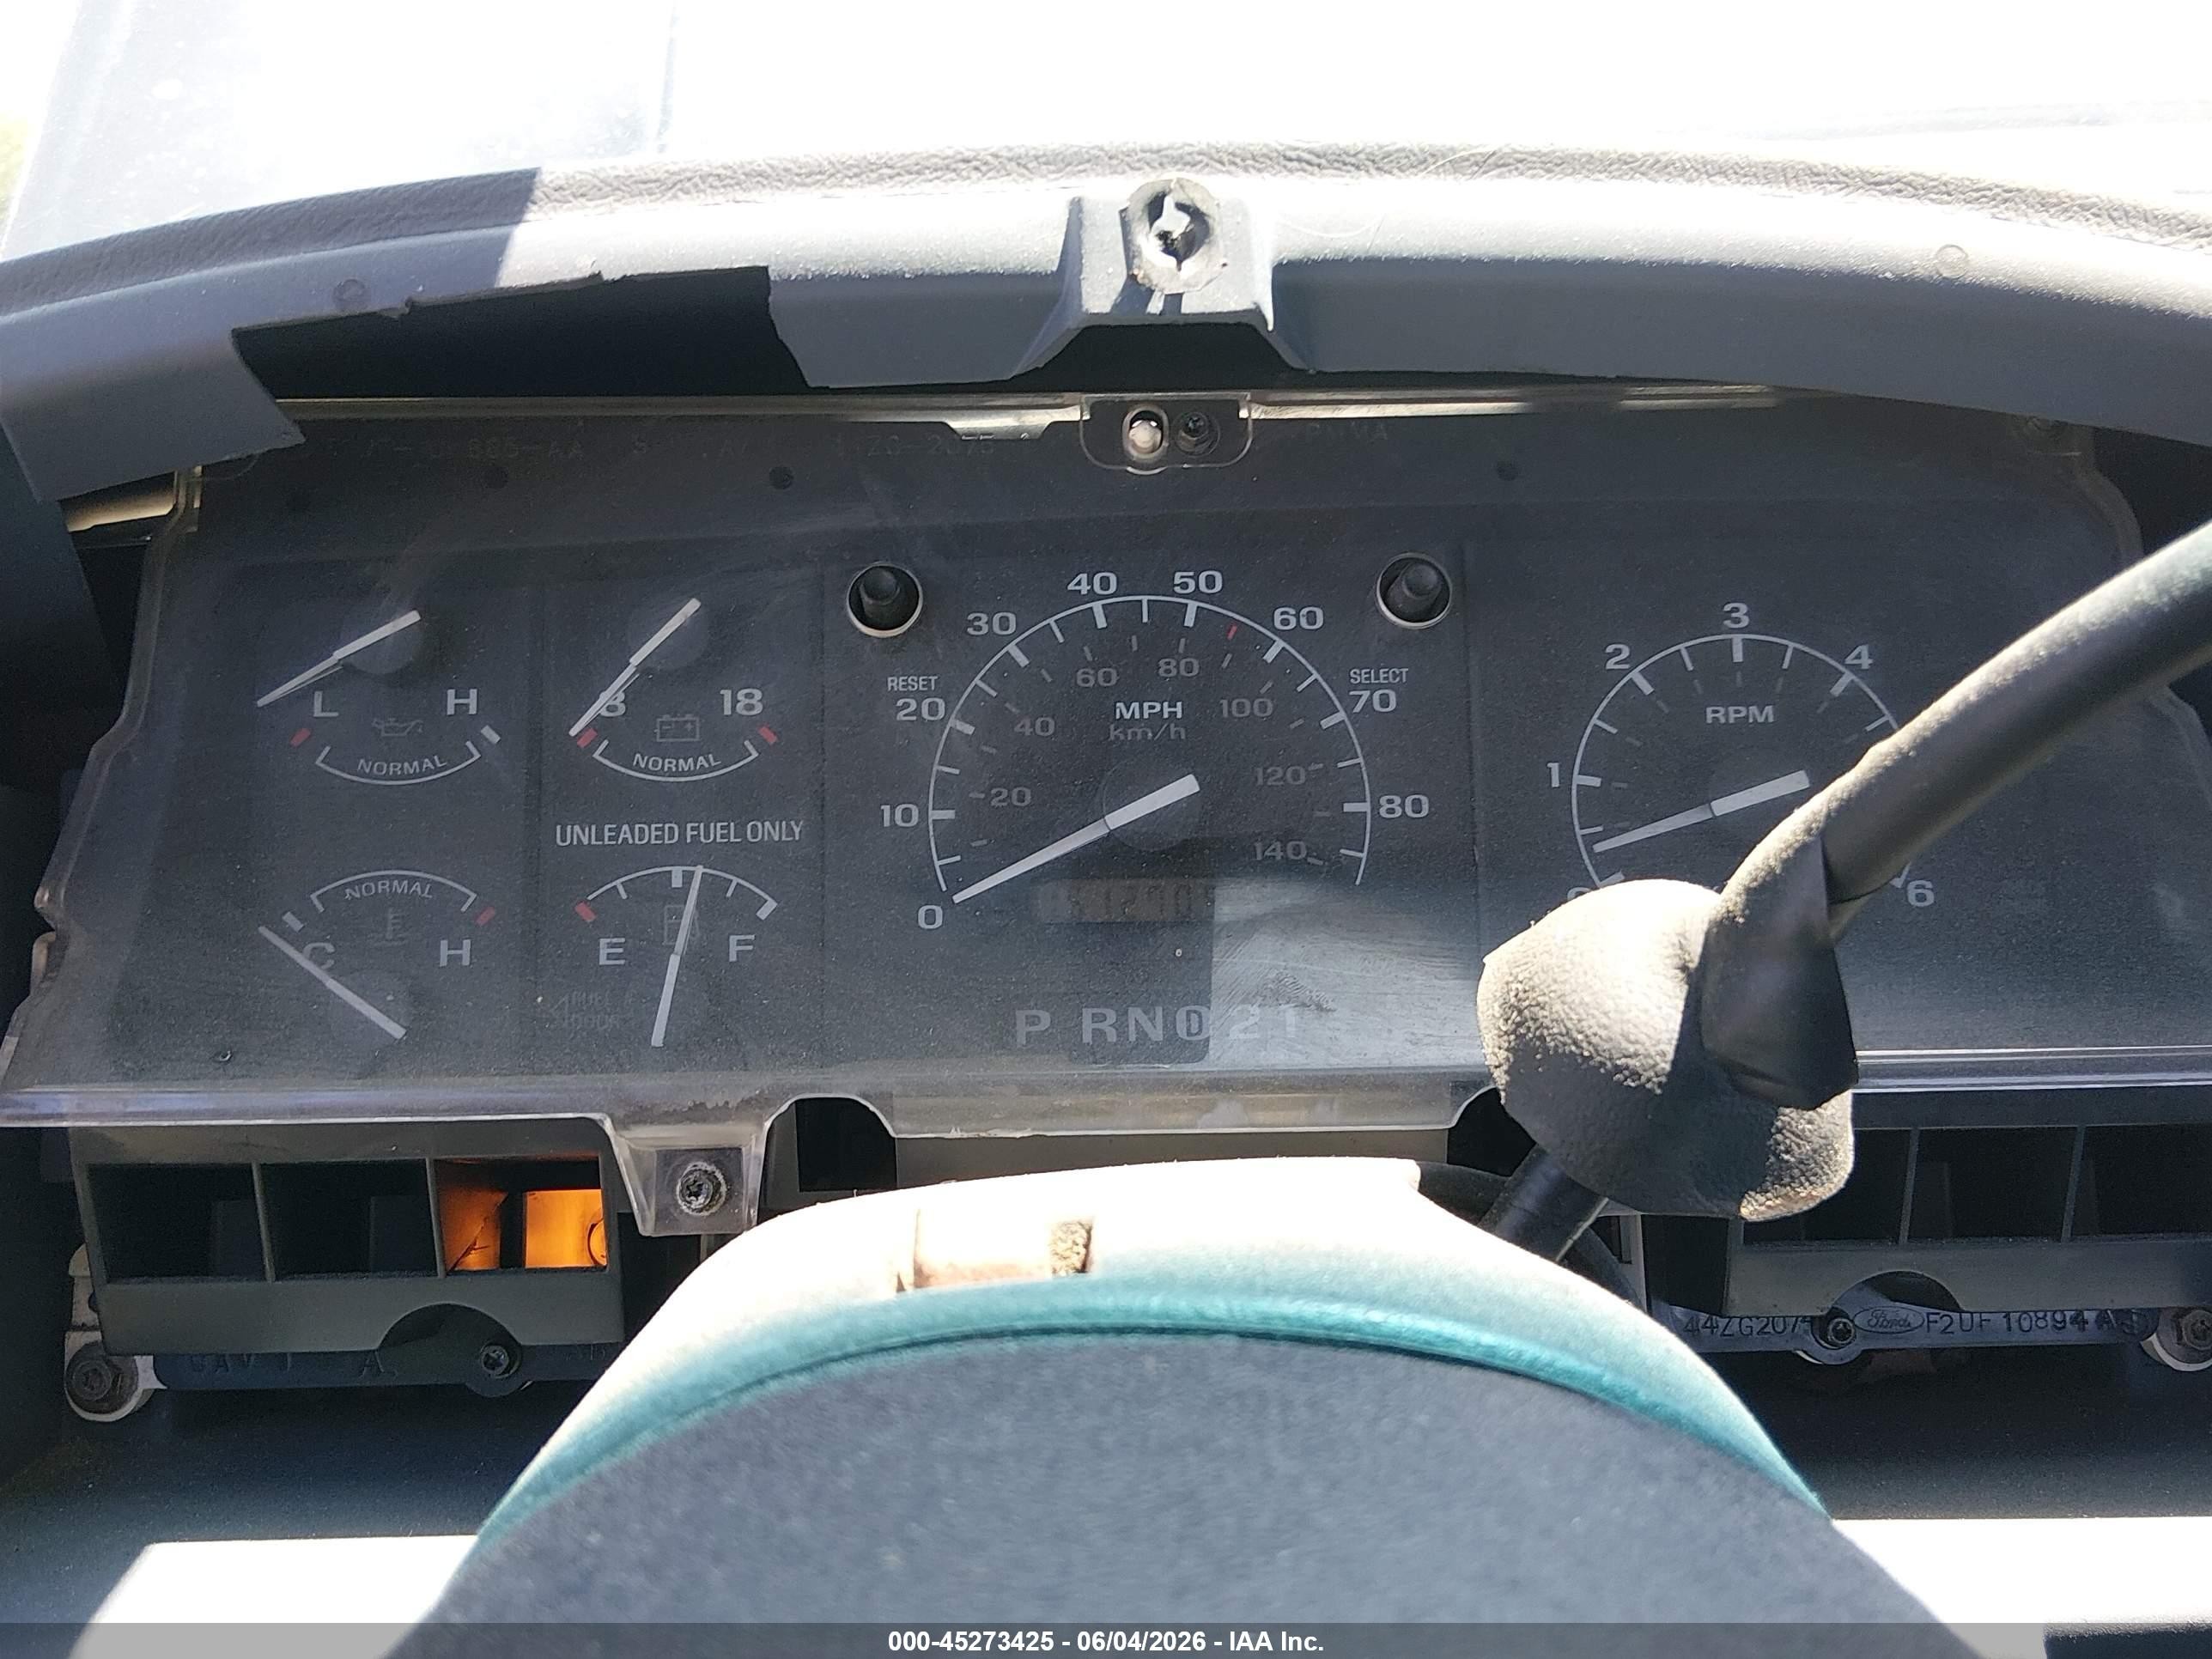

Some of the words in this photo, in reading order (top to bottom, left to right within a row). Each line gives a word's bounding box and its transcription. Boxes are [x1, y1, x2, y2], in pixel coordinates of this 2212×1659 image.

[1067, 571, 1117, 596] 40
[1173, 570, 1224, 595] 50
[966, 612, 1017, 637] 30
[1273, 606, 1324, 631] 60
[1723, 603, 1749, 629] 3
[1158, 657, 1200, 678] 80
[1605, 644, 1632, 669] 2
[1845, 644, 1874, 669] 4
[887, 675, 939, 691] RESET
[1076, 666, 1117, 690] 60
[1349, 666, 1408, 684] SELECT
[313, 690, 340, 718] L
[447, 689, 477, 715] H
[720, 688, 763, 716] 18
[895, 698, 945, 722] 20
[1115, 702, 1183, 720] MPH
[1219, 697, 1273, 720] 100
[1349, 690, 1397, 714] 70
[1014, 715, 1055, 738] 40
[1705, 706, 1775, 725] RPM
[1109, 723, 1187, 744] km/h
[356, 755, 447, 776] NORMAL
[632, 752, 722, 773] NORMAL
[1255, 766, 1307, 787] 120
[1546, 763, 1560, 787] 1
[990, 786, 1031, 809] 20
[1379, 795, 1430, 819] 80
[879, 804, 920, 829] 10
[556, 824, 678, 848] UNLEADED
[687, 823, 742, 845] FUEL
[746, 821, 804, 844] ONLY
[1255, 841, 1308, 861] 140
[344, 879, 434, 900] NORMAL
[1907, 880, 1936, 908] 6
[917, 906, 944, 930] 0
[301, 942, 336, 970] C
[440, 939, 471, 968] H
[599, 937, 626, 965] E
[729, 934, 756, 962] F
